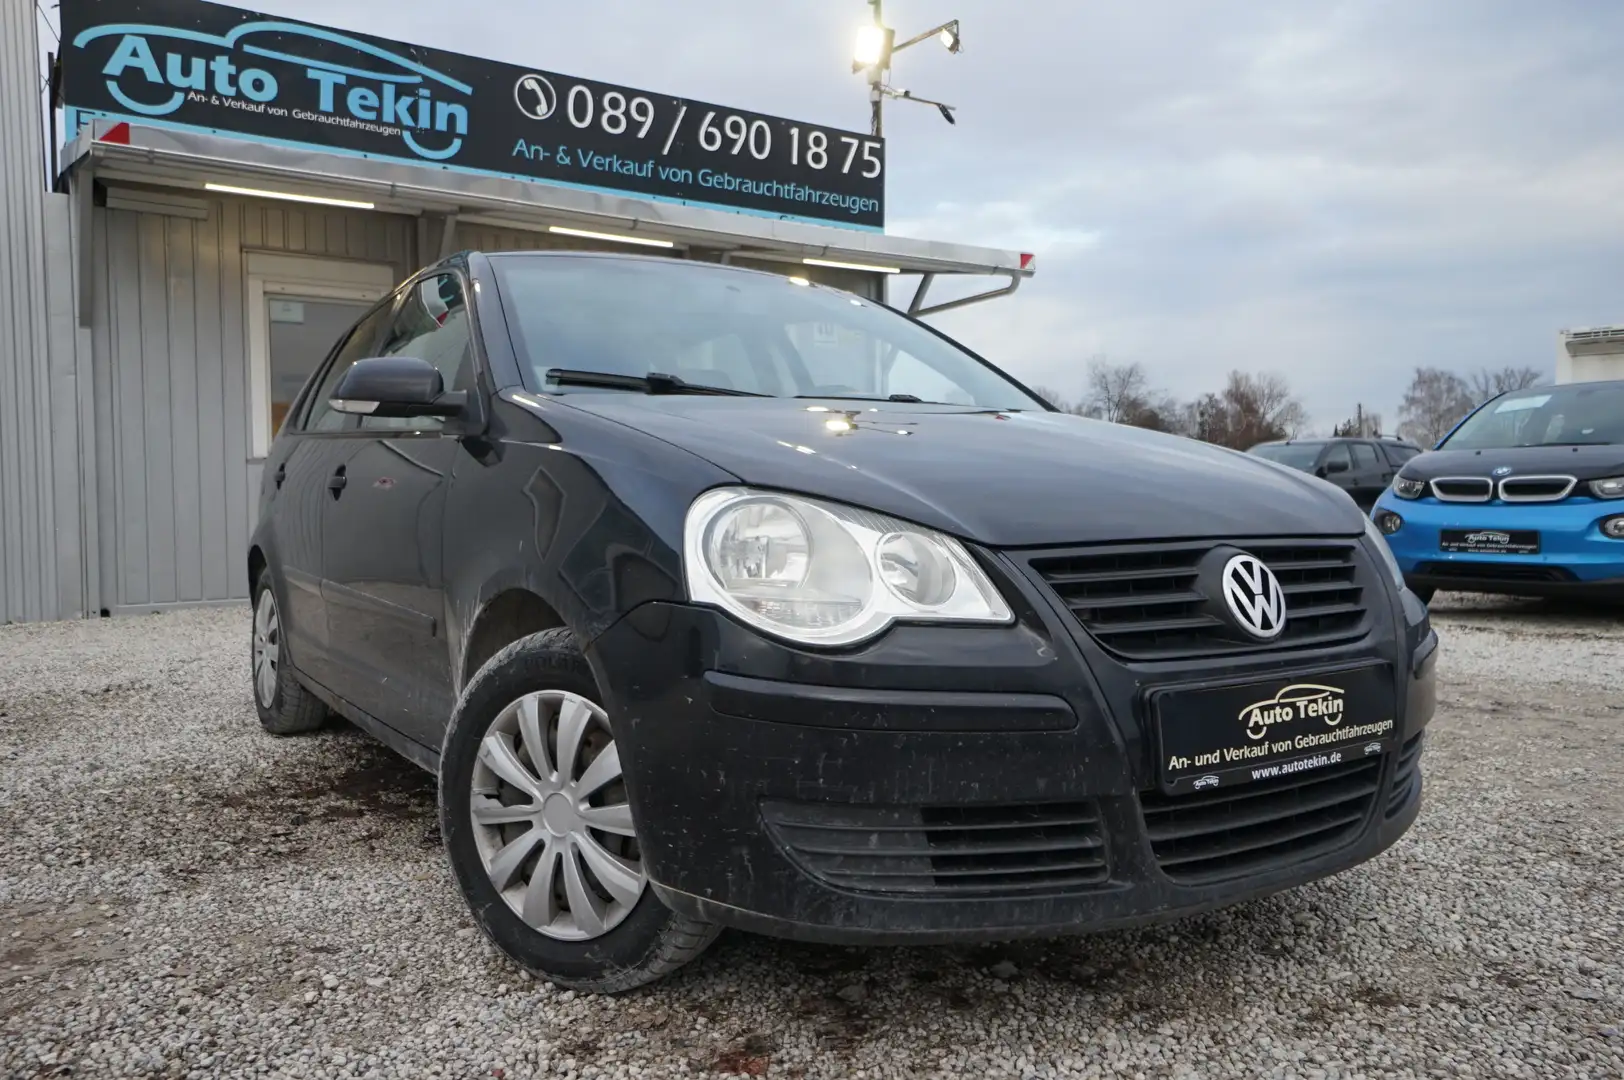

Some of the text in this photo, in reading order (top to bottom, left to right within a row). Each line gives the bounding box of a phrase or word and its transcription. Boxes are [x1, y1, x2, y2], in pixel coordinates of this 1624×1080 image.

[103, 35, 468, 135] Auto Tekin
[187, 91, 401, 136] An- & Verkauf von Gebrauchtfahrzeugen
[567, 84, 881, 179] 089 / 690 18 75
[512, 138, 879, 214] An- & Verkauf von Gebrauchtfahrzeugen
[1248, 696, 1343, 728] Auto Tekin
[1168, 756, 1191, 770] An-
[1194, 752, 1220, 766] und
[1223, 745, 1269, 762] Verkauf
[1271, 742, 1292, 754] von
[1294, 719, 1393, 749] Gebrauchtfahrzeugen
[1251, 752, 1342, 779] www.autotekin.de
